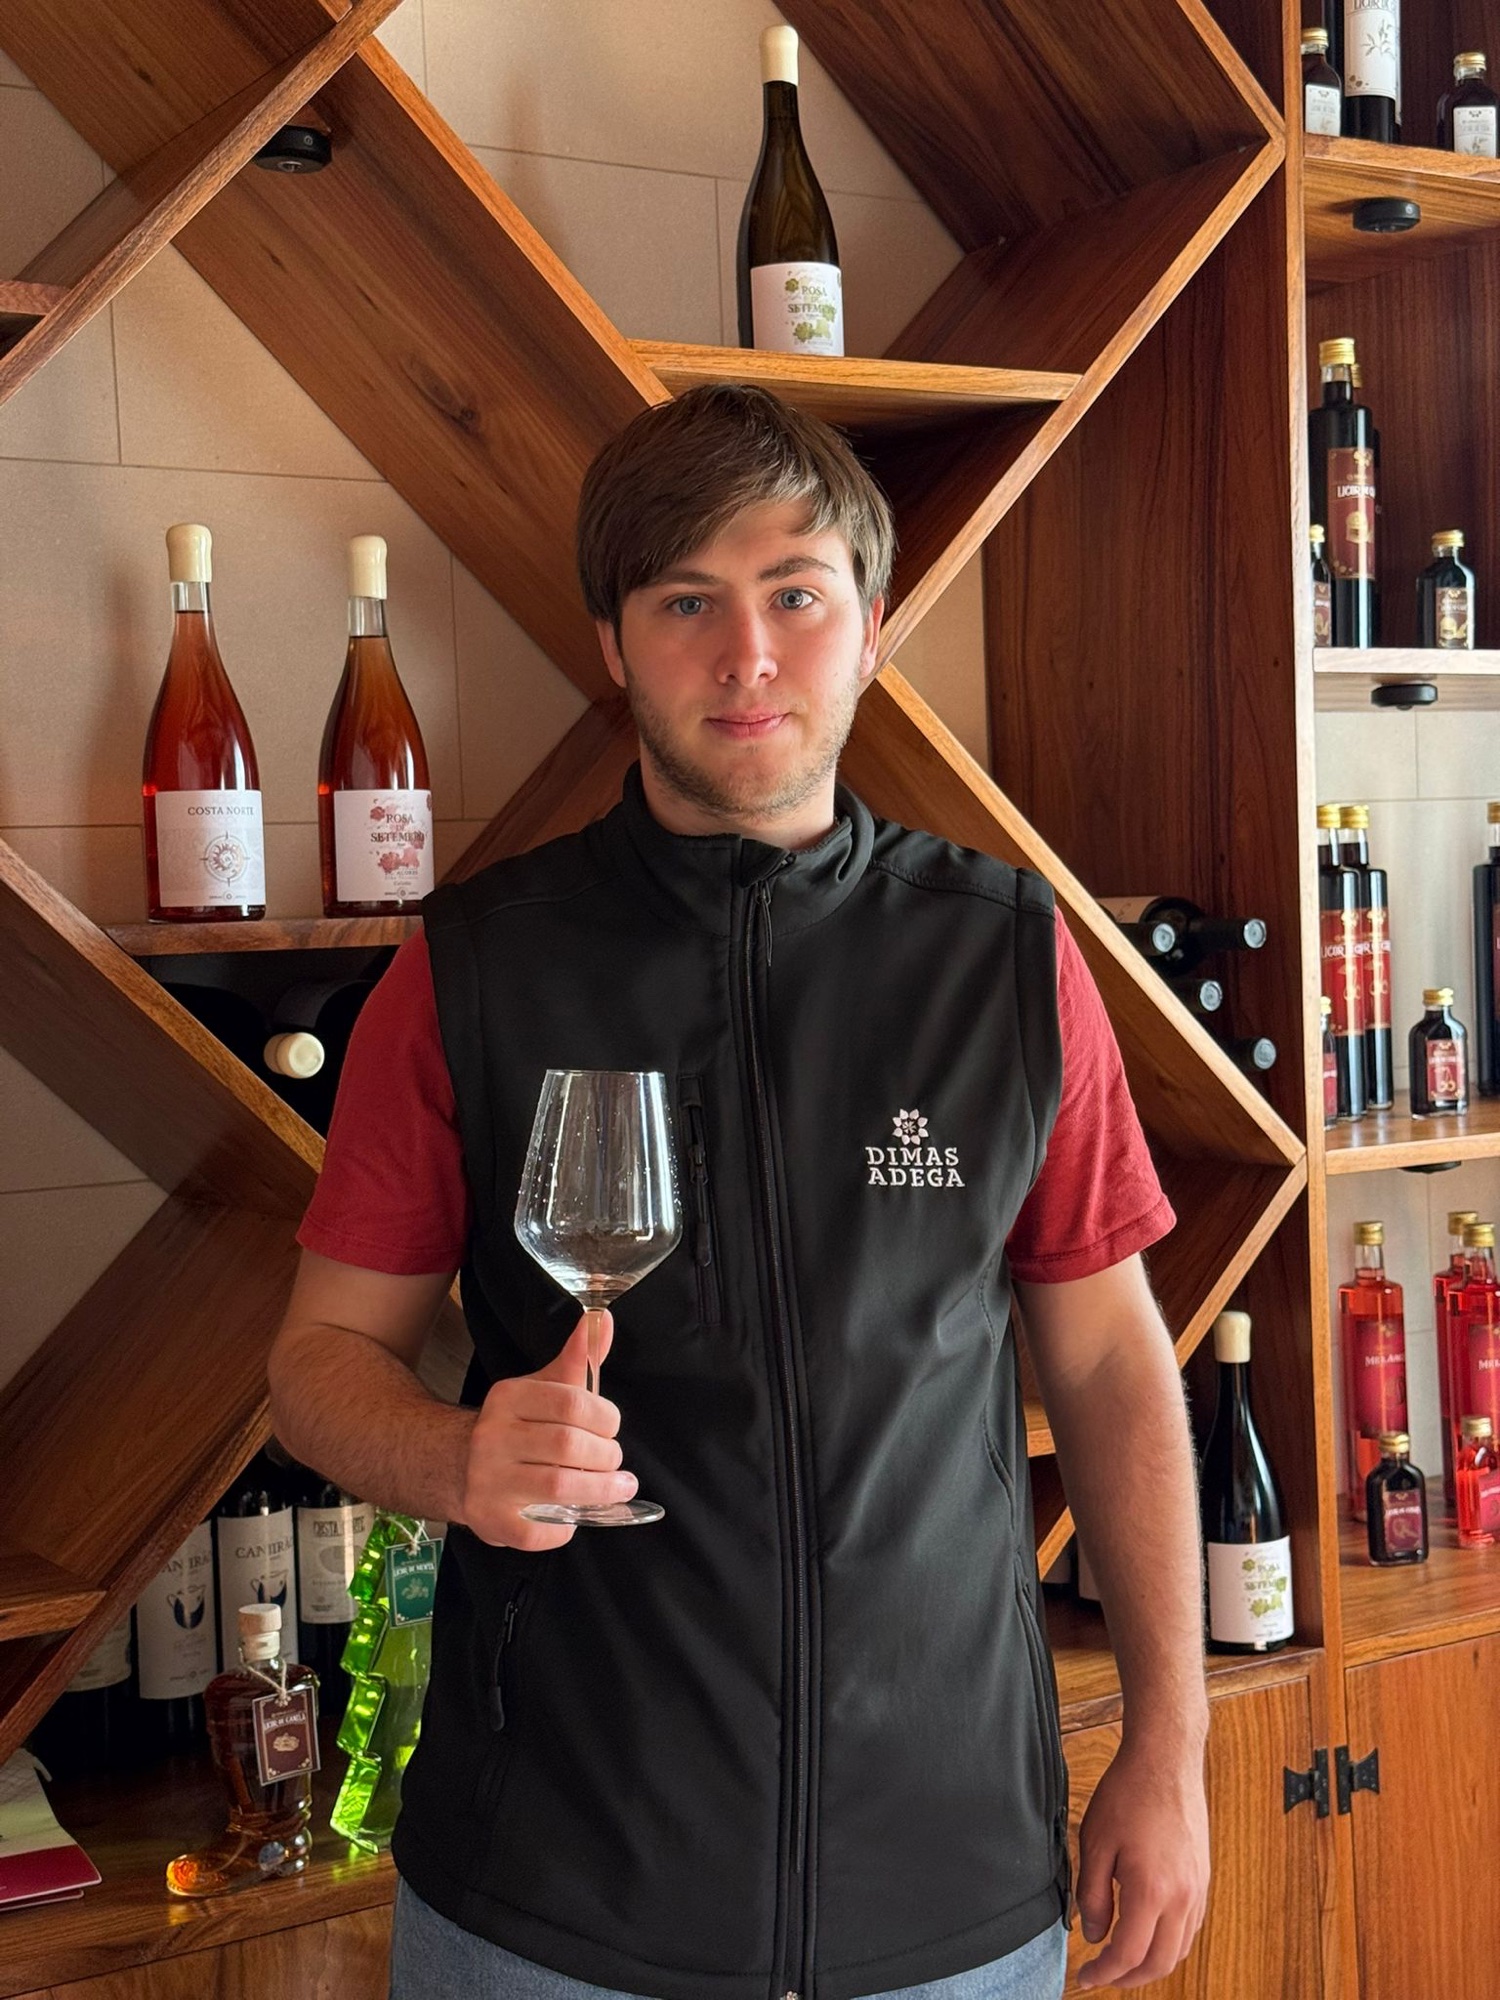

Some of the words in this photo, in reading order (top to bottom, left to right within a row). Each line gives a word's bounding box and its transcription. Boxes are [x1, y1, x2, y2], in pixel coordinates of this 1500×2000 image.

[187, 806, 224, 816] COSTA
[226, 806, 254, 816] NORTE
[386, 813, 414, 824] ROSA
[865, 1146, 959, 1166] DIMAS
[868, 1167, 965, 1187] ADEGA
